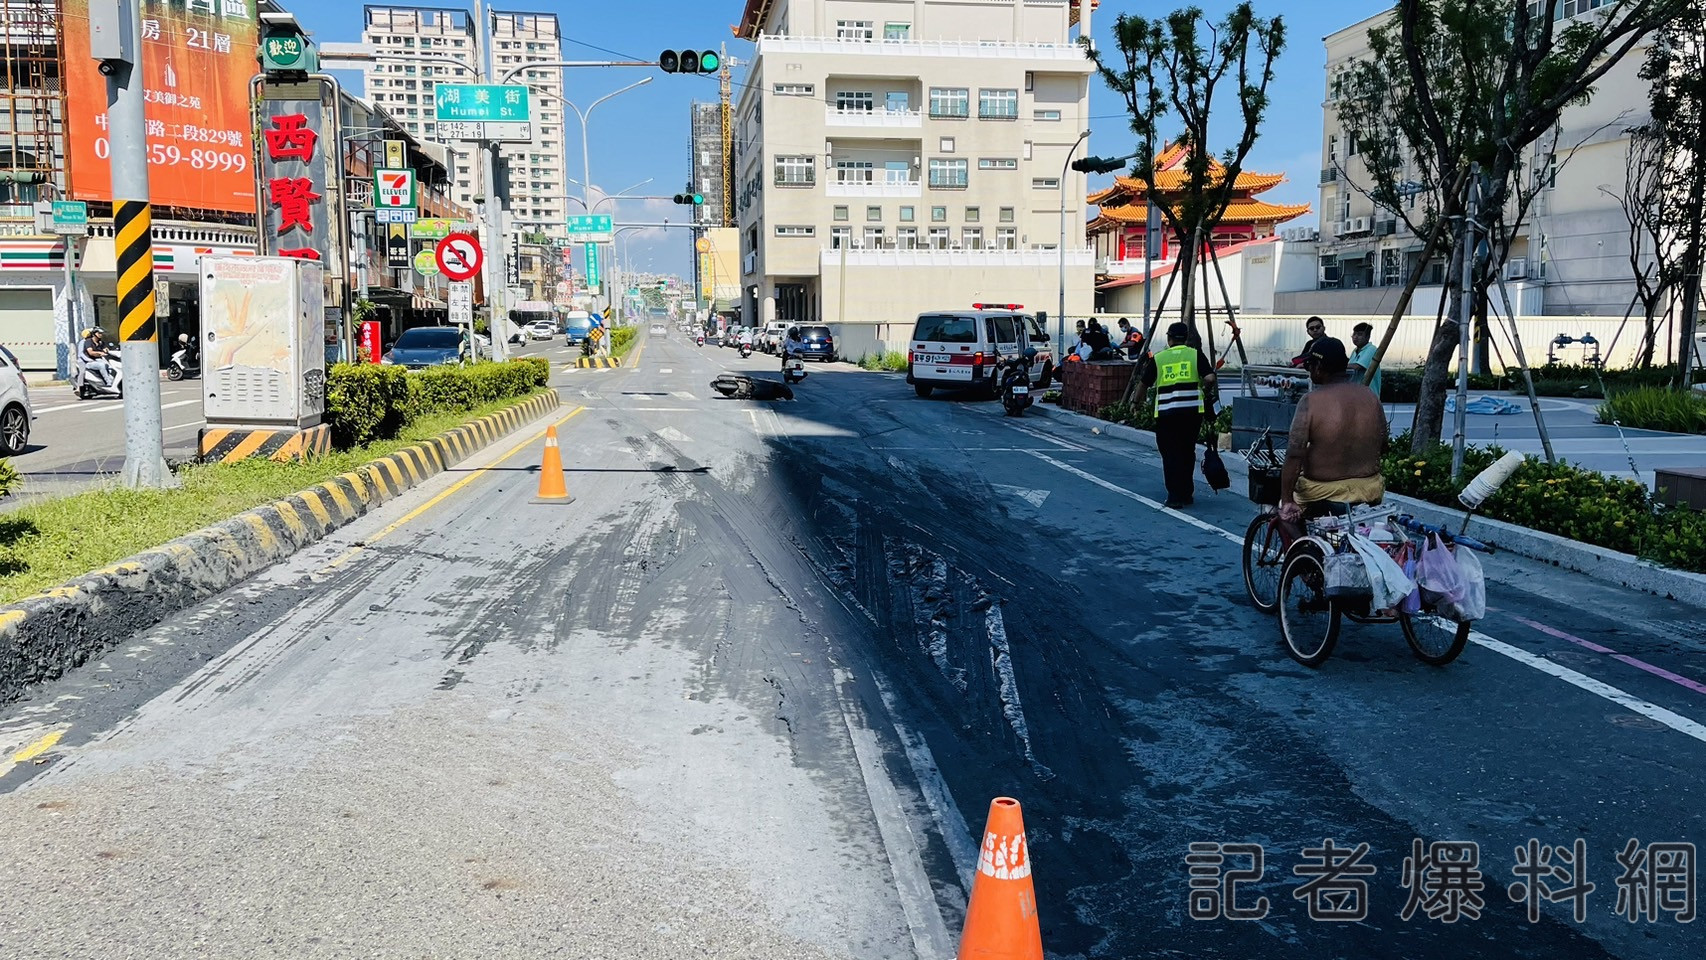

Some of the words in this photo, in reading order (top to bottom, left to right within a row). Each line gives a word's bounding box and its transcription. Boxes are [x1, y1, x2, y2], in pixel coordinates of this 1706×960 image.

[141, 19, 160, 41] 房
[185, 27, 231, 54] 21層
[268, 38, 299, 57] 歡迎
[443, 87, 521, 105] 湖美街
[450, 106, 490, 117] Humei
[500, 107, 516, 117] St.
